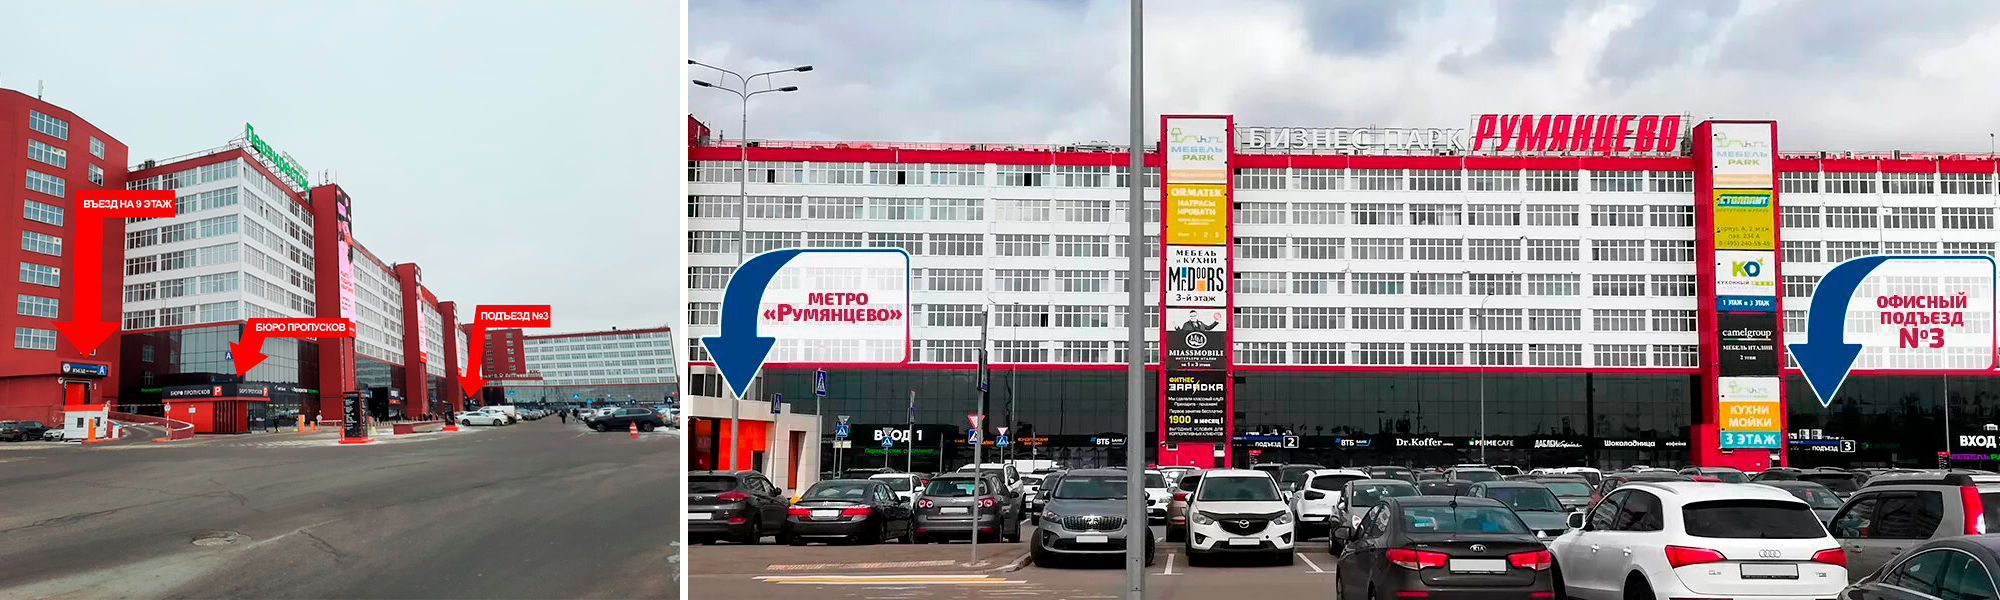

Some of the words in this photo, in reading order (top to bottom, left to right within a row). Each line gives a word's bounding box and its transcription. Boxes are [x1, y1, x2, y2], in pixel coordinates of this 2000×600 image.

[1250, 127, 1369, 150] БИЗНЕС
[1384, 127, 1465, 150] ПАРК
[1473, 114, 1681, 157] РУМЯНЦЕВО
[1176, 294, 1192, 302] 3-й
[1722, 328, 1772, 339] camelgroup
[1730, 406, 1770, 414] КУХНИ
[1169, 416, 1191, 424] 1900
[1728, 416, 1772, 427] МОЙКИ
[874, 430, 911, 442] ВОД
[916, 430, 922, 441] 1
[1725, 432, 1734, 445] 3
[1736, 434, 1776, 445] ЭТАЖ
[1096, 438, 1110, 446] ВТБ
[1287, 437, 1295, 447] 2
[1396, 438, 1443, 446] Dr.Koffer
[1844, 441, 1852, 451] 3
[1960, 436, 1997, 448] ВХОД
